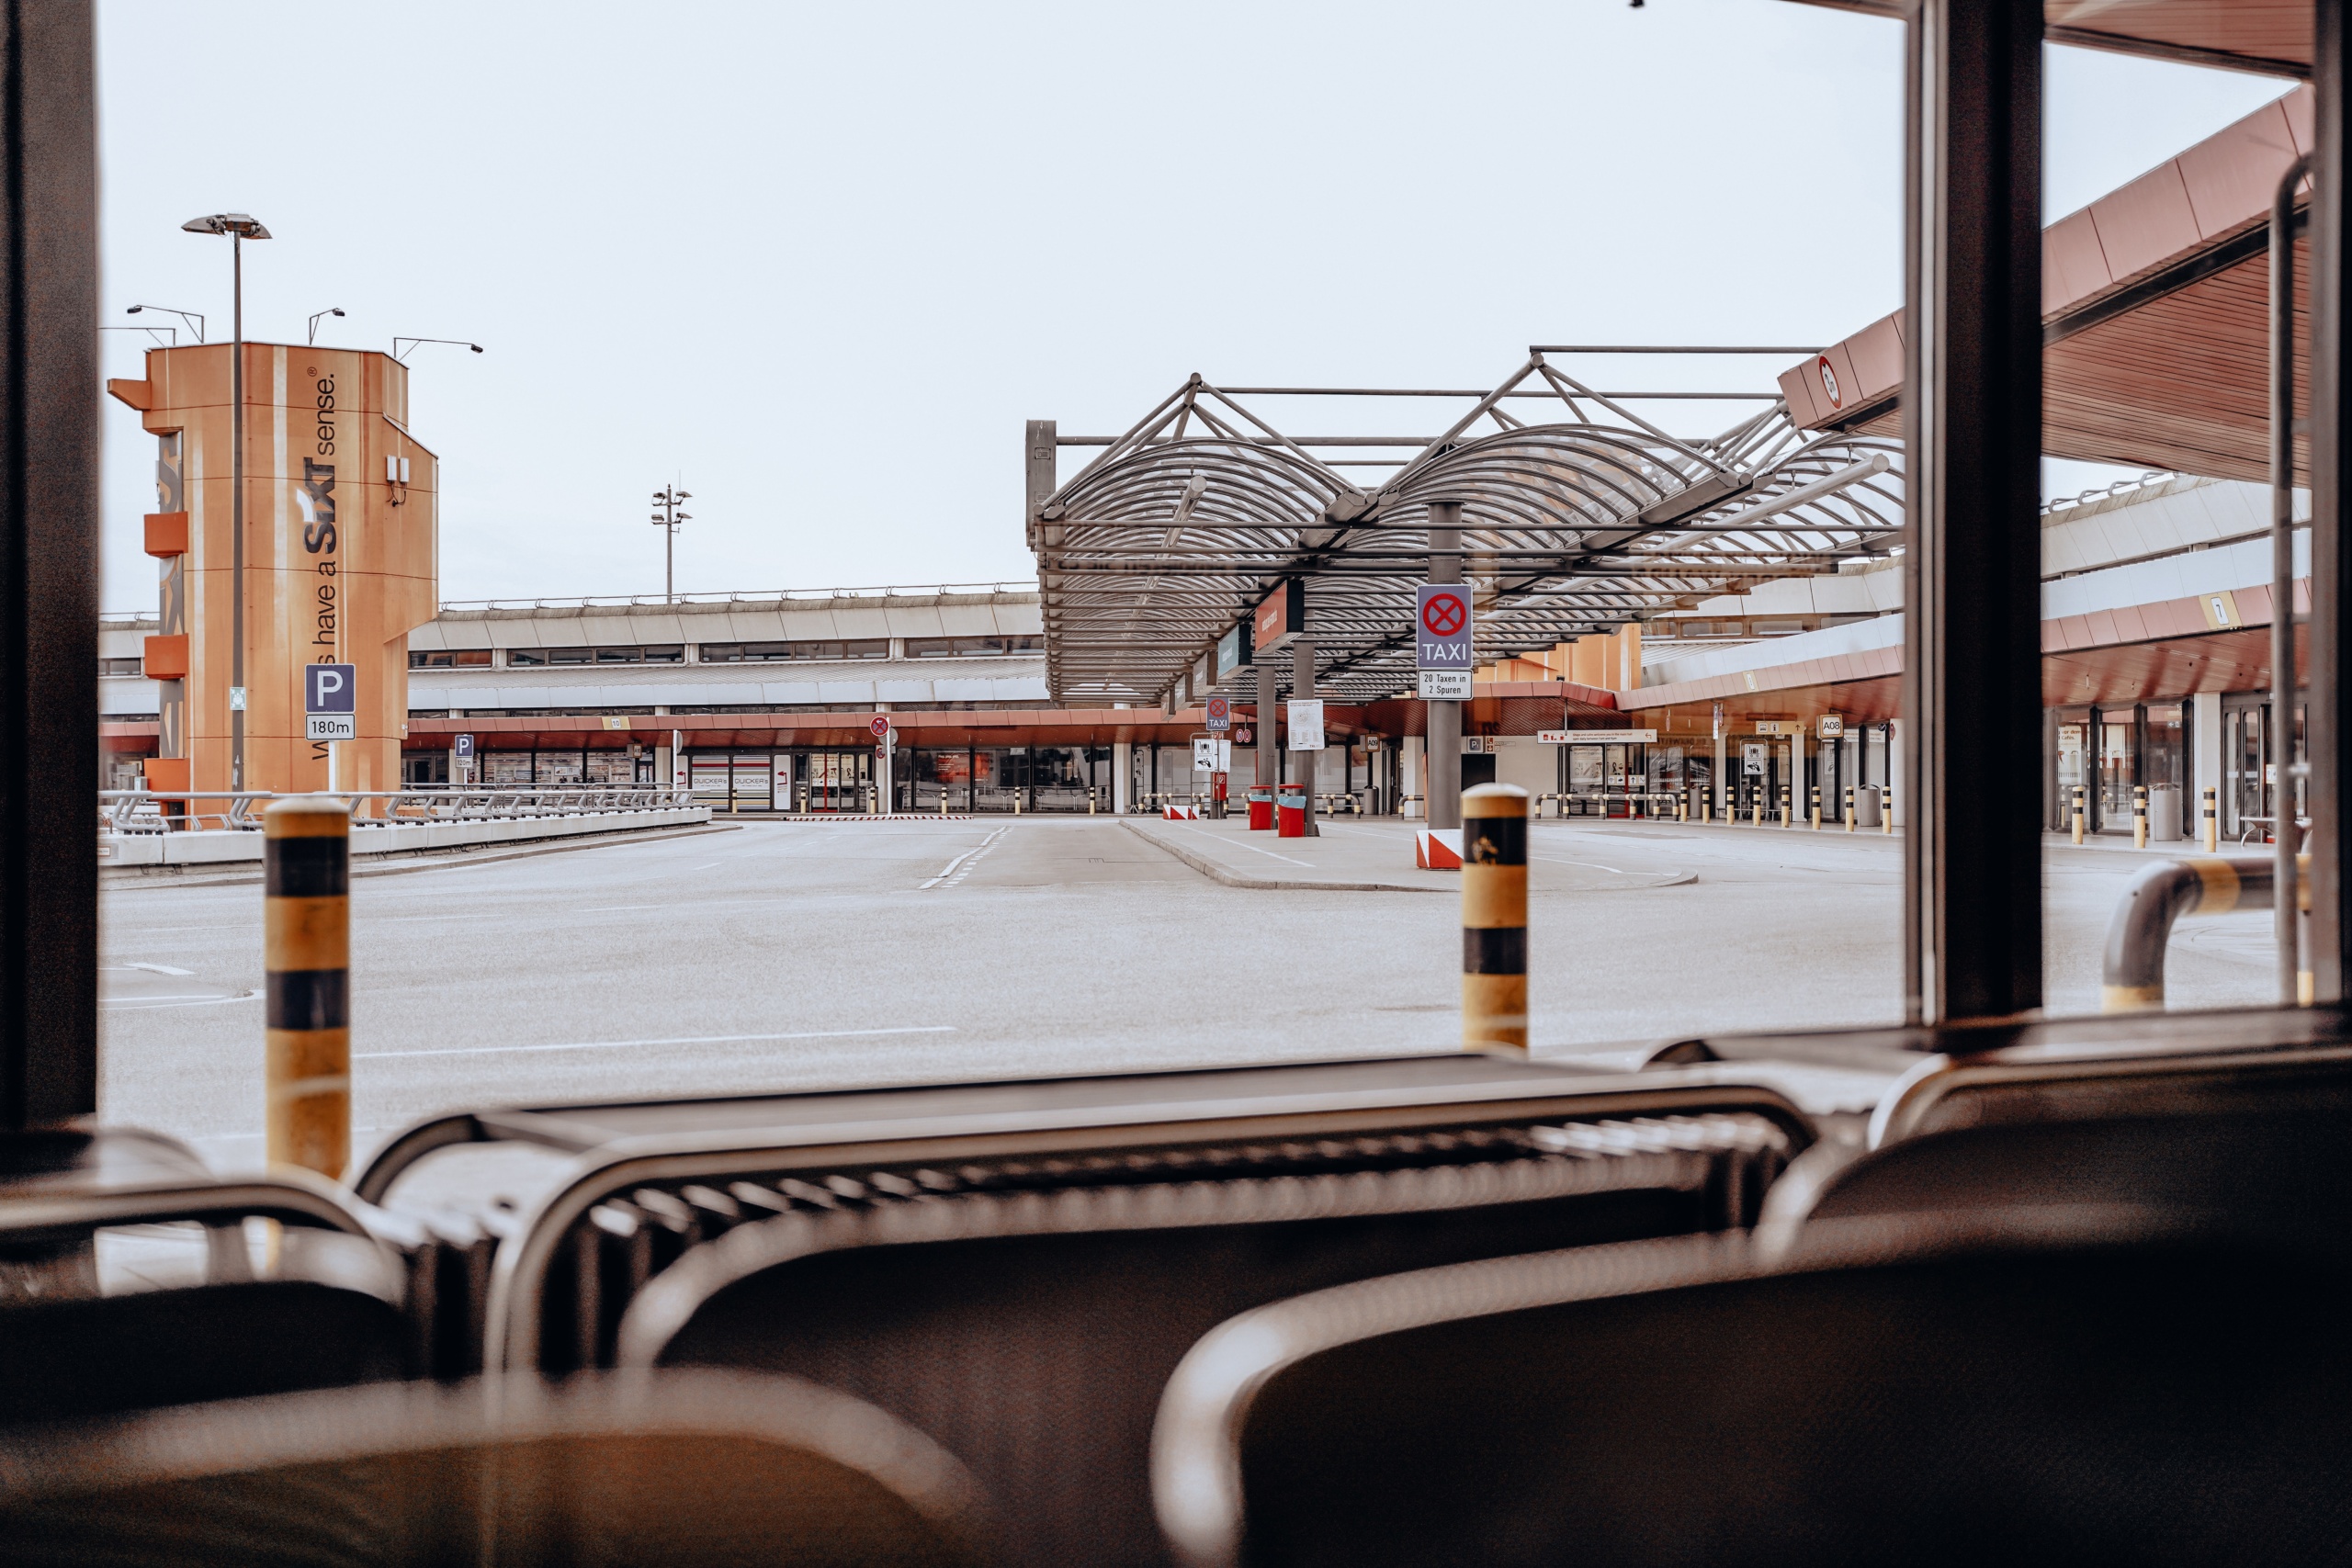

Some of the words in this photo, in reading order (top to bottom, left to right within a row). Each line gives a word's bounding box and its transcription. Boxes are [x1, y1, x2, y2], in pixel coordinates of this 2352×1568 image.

[317, 373, 335, 457] sense.
[318, 560, 336, 577] a
[312, 584, 335, 645] have
[1422, 643, 1466, 660] TAXI
[1424, 673, 1433, 682] 20
[1436, 673, 1457, 682] Taxen
[1459, 673, 1466, 682] in
[317, 671, 344, 707] P
[1429, 685, 1433, 694] 2
[1436, 685, 1462, 695] Spuren
[311, 721, 349, 734] 180m
[1209, 719, 1227, 728] TAXI
[1823, 722, 1840, 730] A08
[459, 738, 469, 754] P
